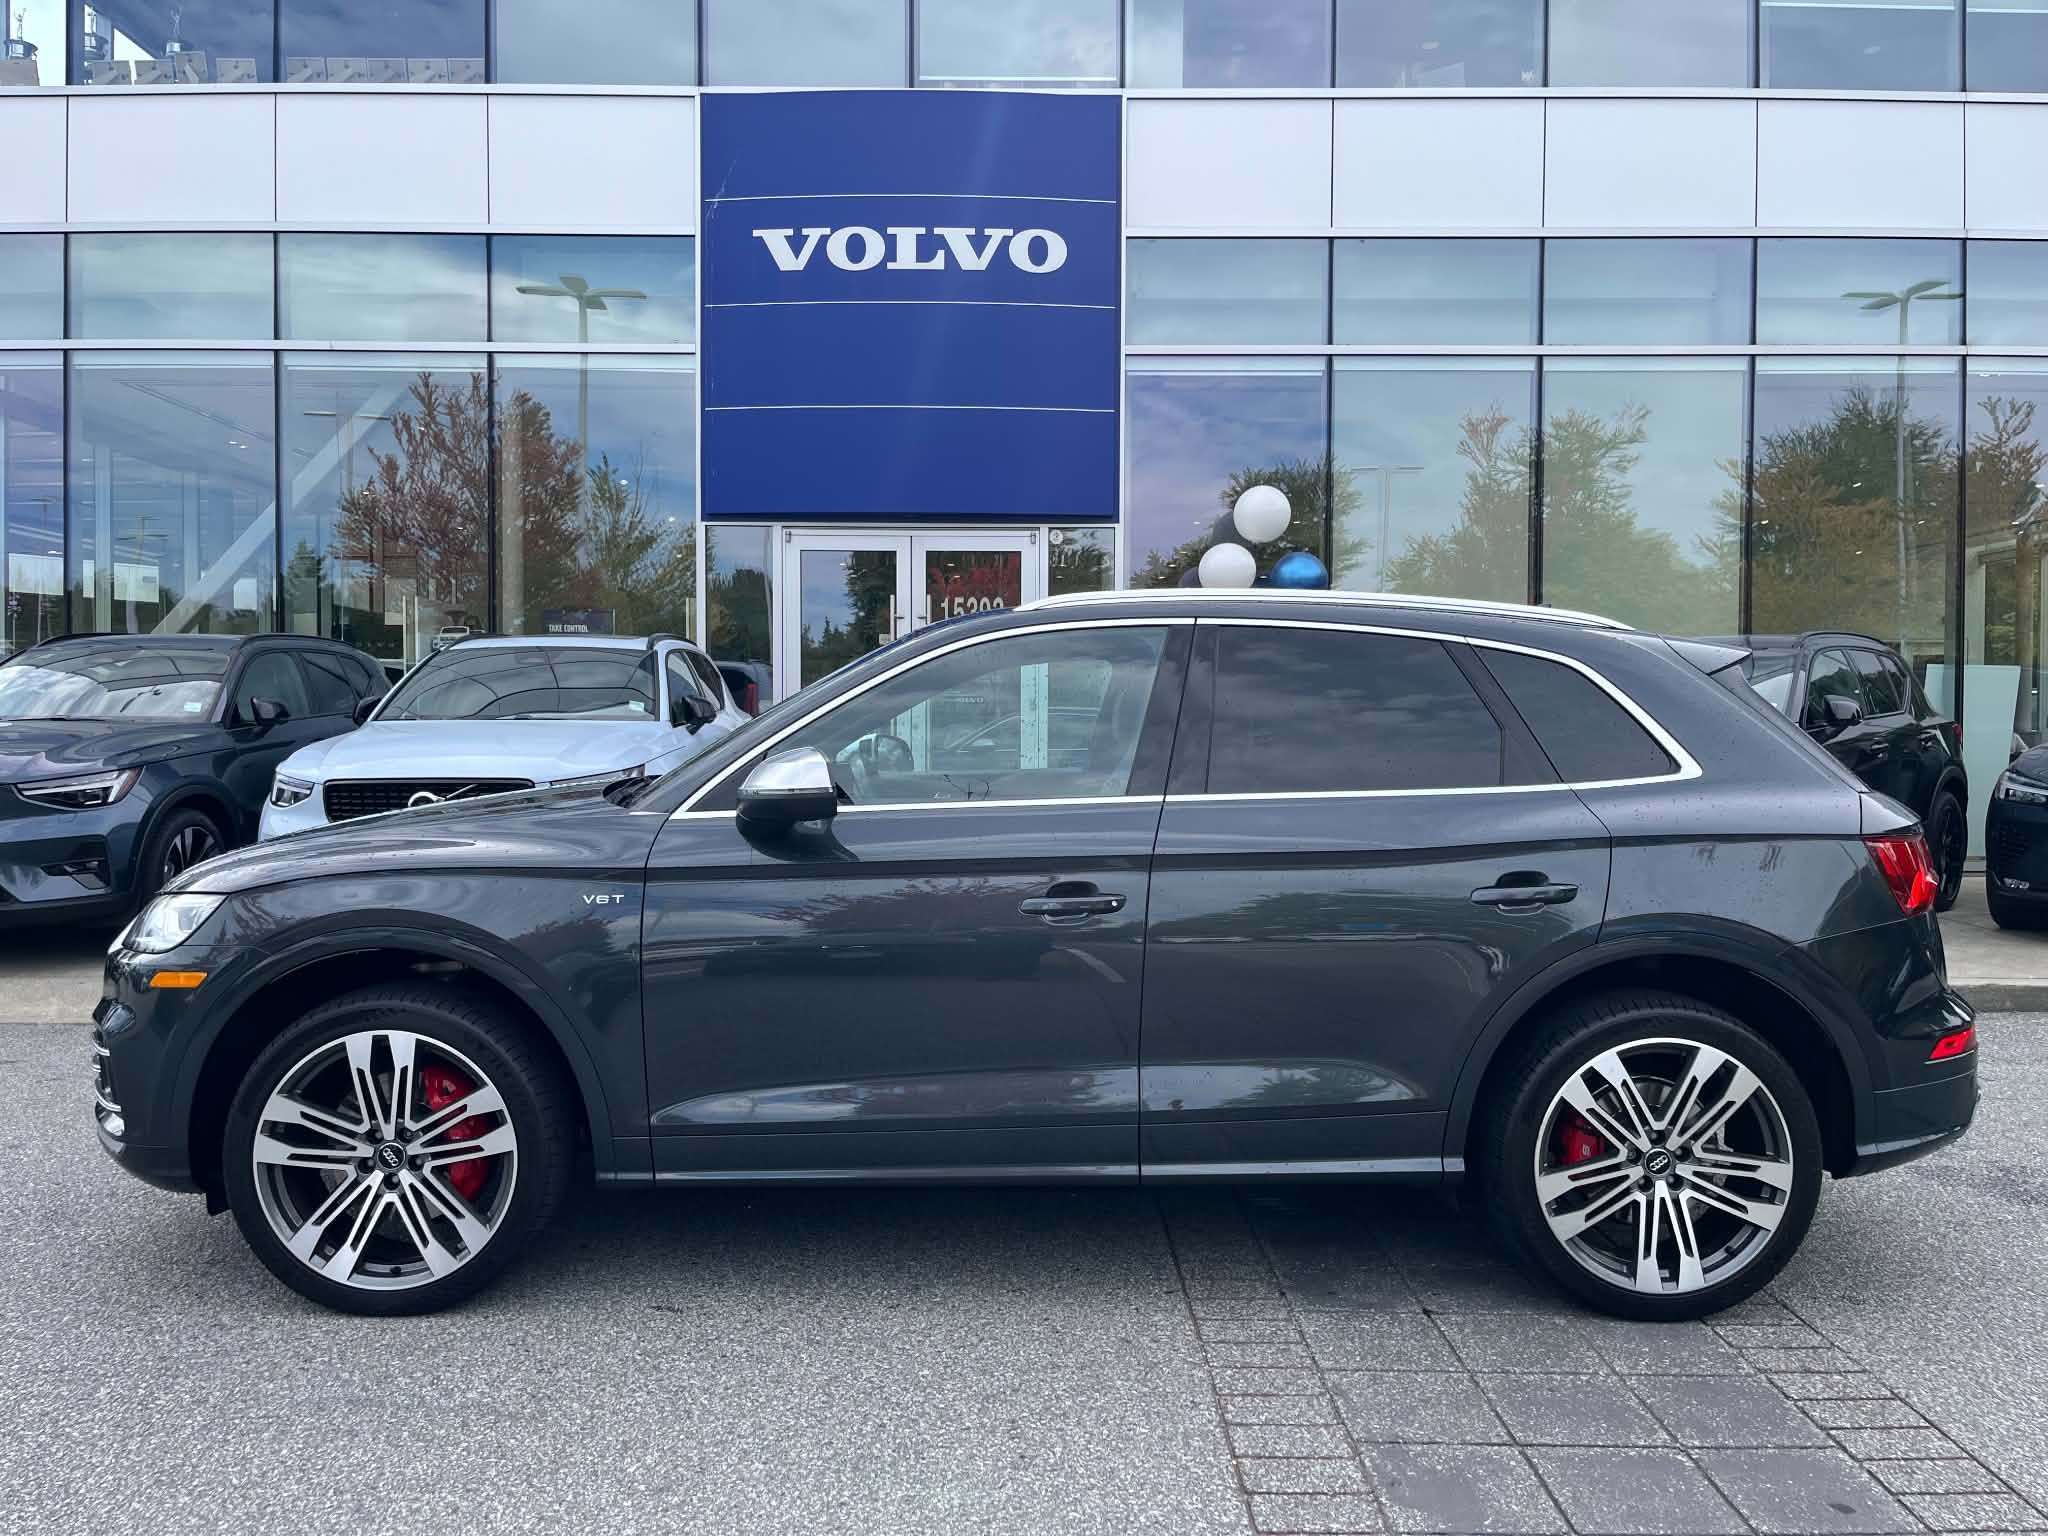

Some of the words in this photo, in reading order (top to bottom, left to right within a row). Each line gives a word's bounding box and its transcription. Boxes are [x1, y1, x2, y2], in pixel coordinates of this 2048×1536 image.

[752, 226, 1068, 274] VOLVO
[563, 624, 588, 633] CONTROL
[583, 894, 625, 904] V6T
